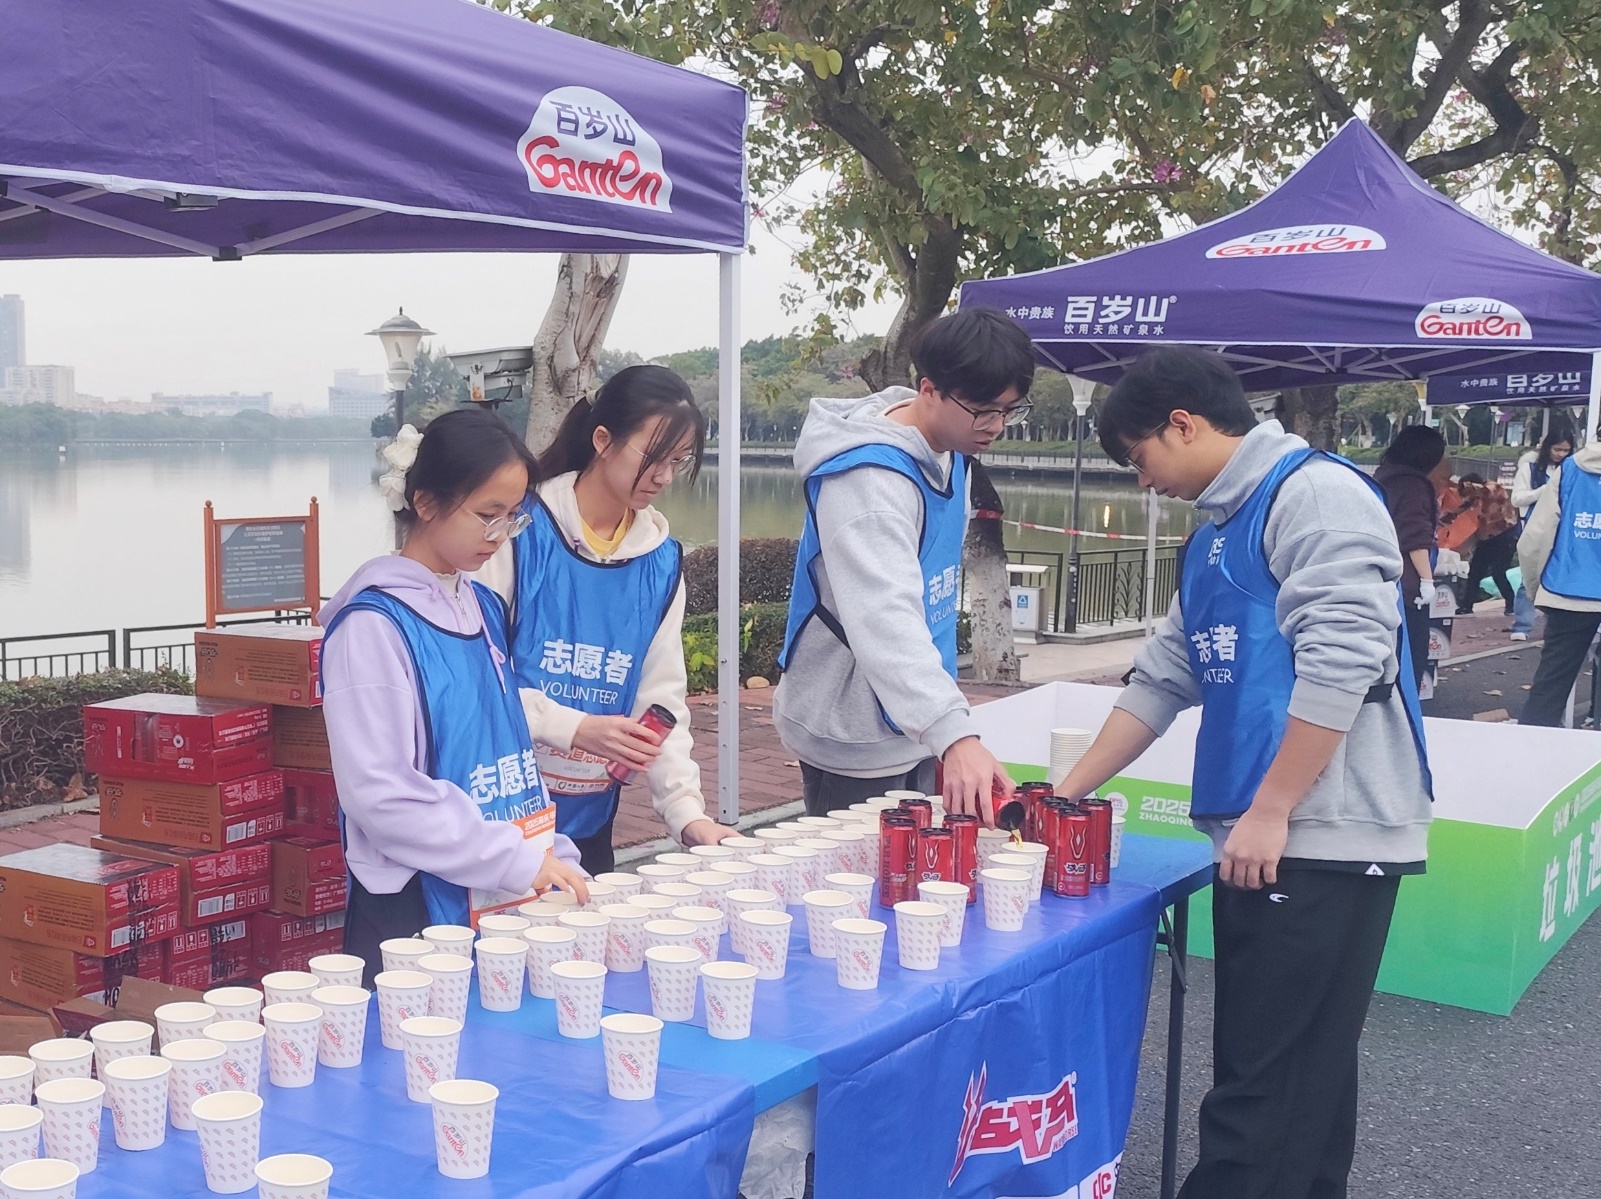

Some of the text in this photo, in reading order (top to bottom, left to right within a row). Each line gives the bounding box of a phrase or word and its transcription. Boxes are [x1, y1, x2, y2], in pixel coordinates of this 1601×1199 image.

[549, 99, 637, 147] 百岁山
[524, 135, 663, 206] Ganten
[1250, 226, 1347, 244] 百岁山
[1215, 236, 1373, 257] Ganten
[1005, 306, 1055, 320] 水中贵族
[1439, 303, 1502, 315] 百岁山
[1064, 323, 1165, 336] 饮用天然矿泉水
[1420, 314, 1522, 337] Ganten
[1460, 377, 1499, 389] 水中贵族
[538, 638, 633, 687] 志愿者
[539, 679, 619, 705] VOLUNTEER
[469, 748, 539, 805] 志愿者
[1140, 795, 1191, 817] 2025
